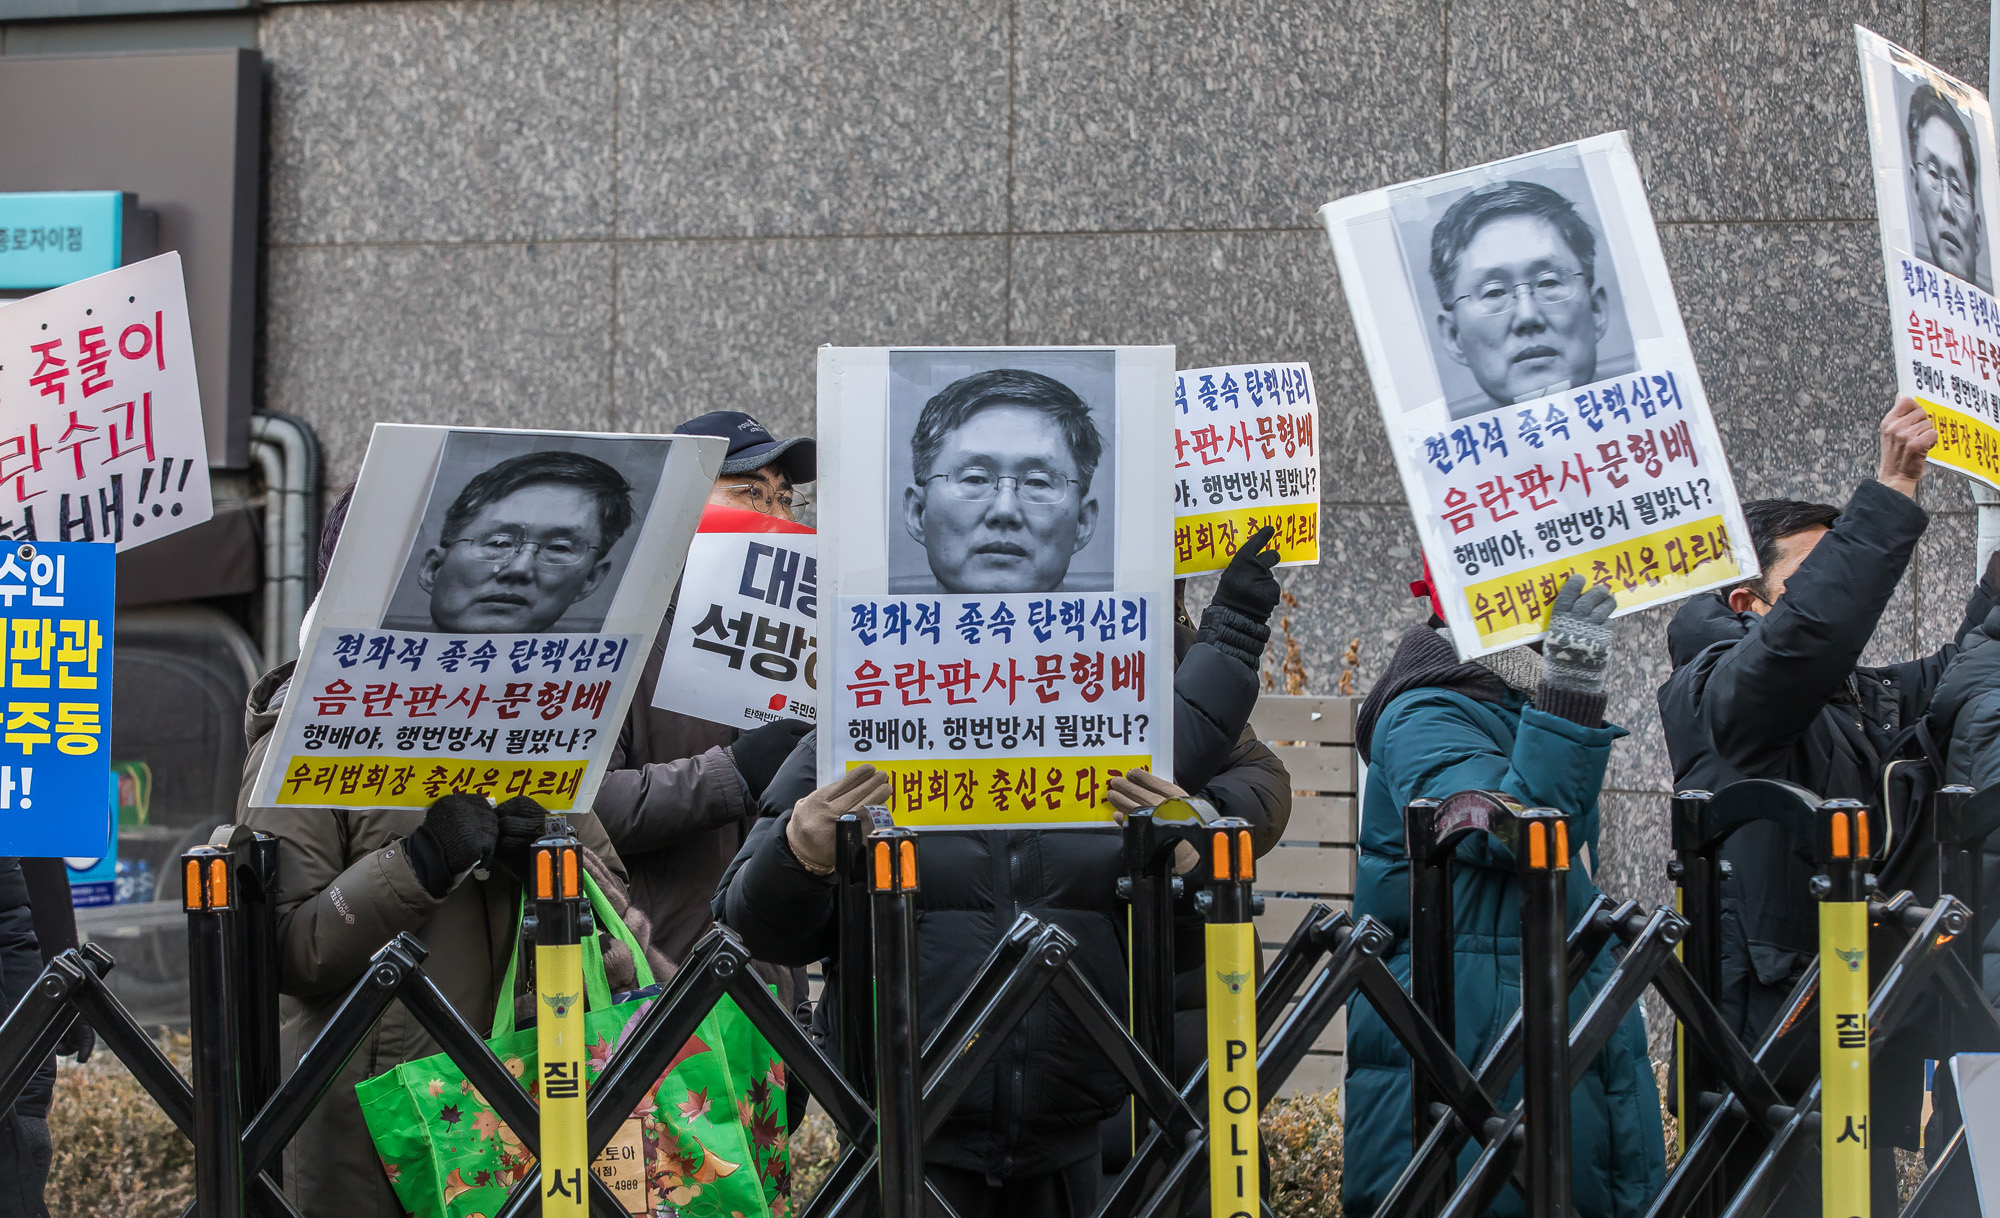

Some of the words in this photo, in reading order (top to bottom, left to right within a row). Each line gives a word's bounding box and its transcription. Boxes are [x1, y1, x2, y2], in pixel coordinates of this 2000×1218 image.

[1944, 278, 1966, 321] 졸속
[29, 310, 166, 405] 죽돌이
[1198, 372, 1239, 412] 졸속
[1245, 367, 1311, 407] 탄핵심리
[1424, 417, 1509, 475] 편파적
[1518, 403, 1571, 448] 졸속
[1574, 369, 1683, 433] 탄핵심리
[1201, 469, 1273, 505] 행번방서
[1453, 530, 1534, 576] 행배야,
[1535, 507, 1630, 553] 행번방서
[1665, 524, 1735, 577] 다르네
[850, 601, 942, 646] 편파적
[955, 600, 1017, 644] 졸속
[1027, 597, 1148, 644] 탄핵심리
[0, 617, 103, 690] 판관
[332, 633, 430, 672] 편파적
[436, 639, 498, 673] 졸속
[508, 636, 629, 673] 탄핵심리
[0, 702, 101, 755] 주동
[303, 723, 384, 751] 행배야,
[395, 725, 498, 752] 행번방서
[848, 717, 935, 752] 행배야,
[943, 715, 1045, 749] 행번방서
[286, 763, 416, 797] 우리법회장
[422, 765, 500, 799] 출신은
[505, 766, 584, 801] 다르네
[988, 766, 1064, 812] 출신은
[1223, 1040, 1252, 1218] POLI
